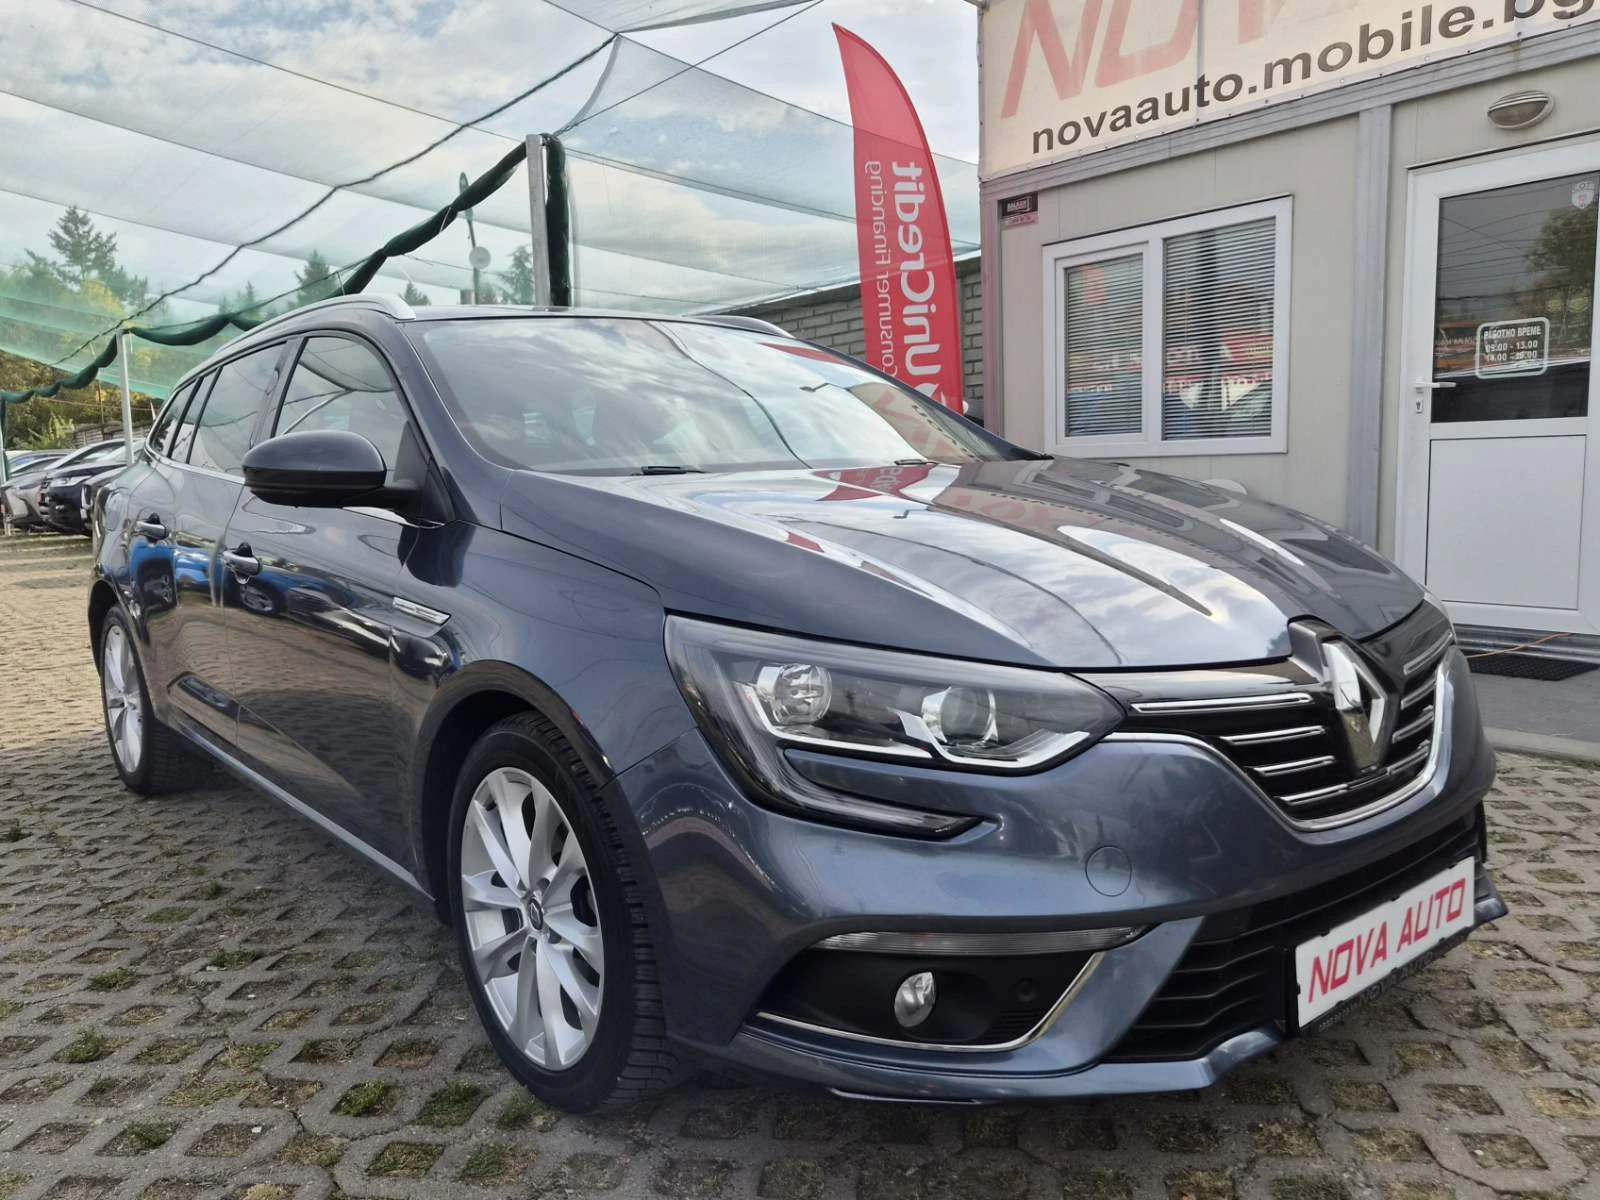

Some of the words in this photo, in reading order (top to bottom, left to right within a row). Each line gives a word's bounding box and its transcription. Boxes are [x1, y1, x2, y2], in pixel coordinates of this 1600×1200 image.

[1517, 325, 1542, 337] ВРЕМЕ
[1308, 921, 1387, 1003] NOVA
[1396, 877, 1466, 953] AUTO
